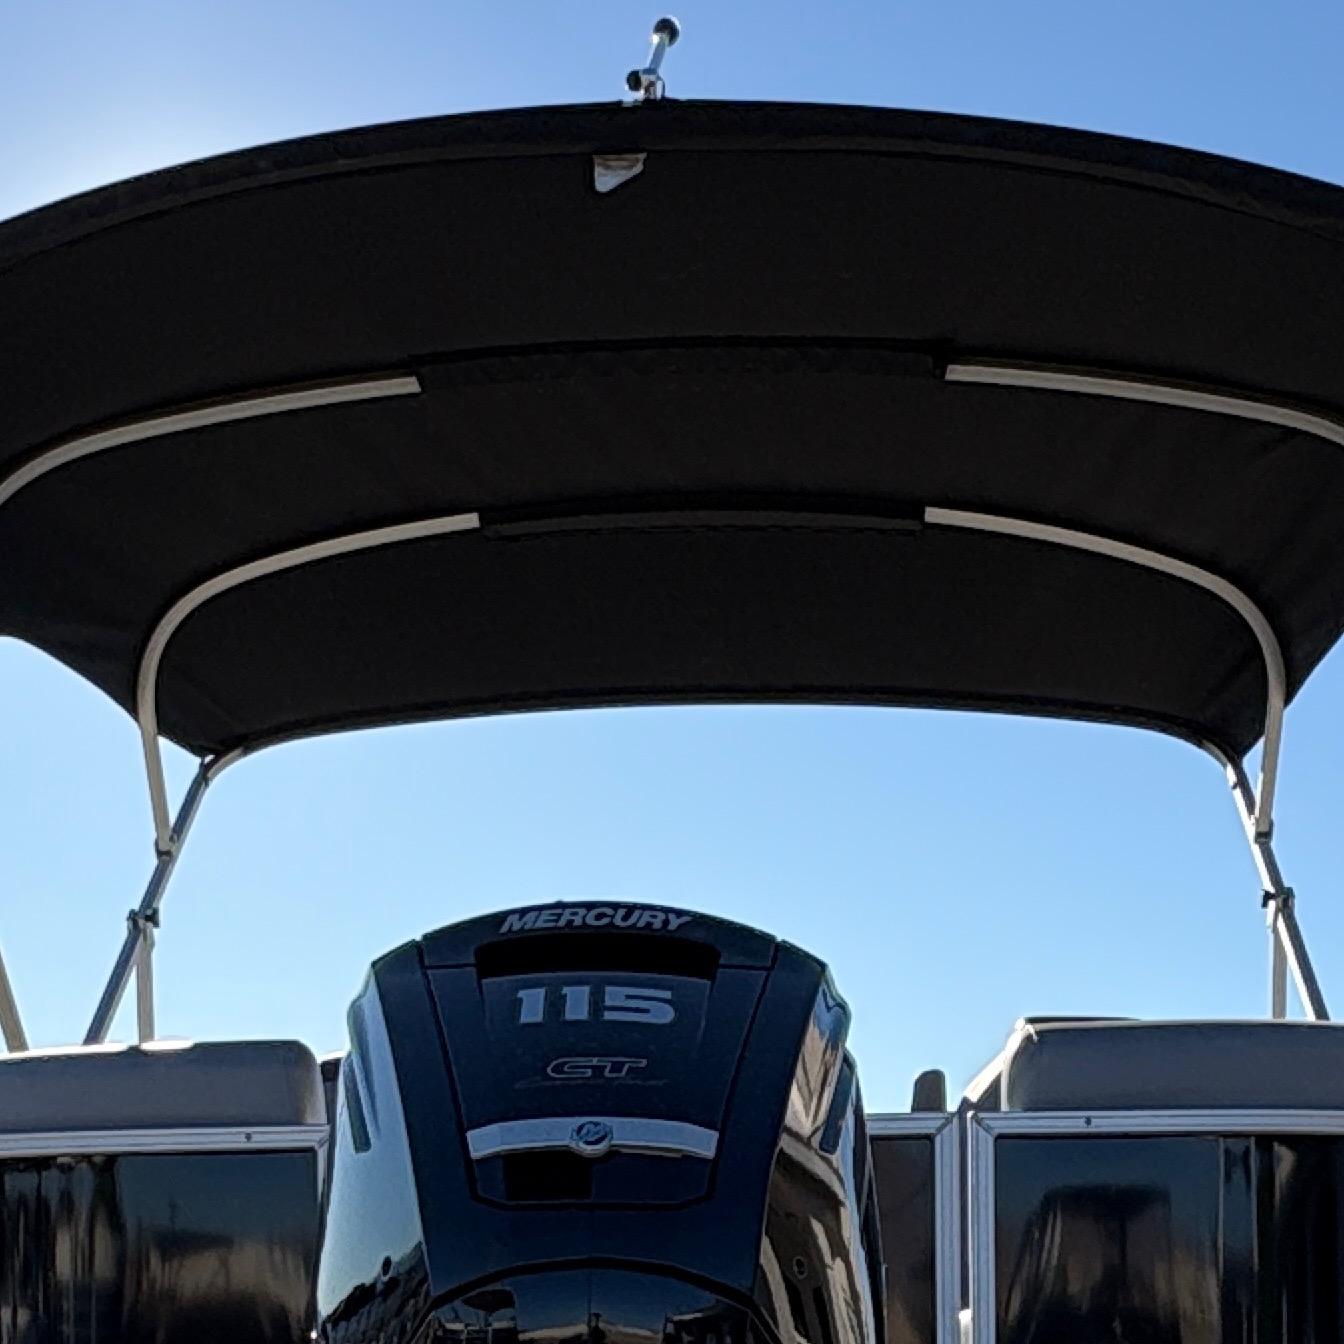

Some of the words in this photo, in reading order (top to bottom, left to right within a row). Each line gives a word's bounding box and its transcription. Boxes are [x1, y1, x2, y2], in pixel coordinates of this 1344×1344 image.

[499, 907, 693, 934] MERCURY
[515, 984, 676, 1025] 115
[546, 1056, 648, 1078] GT
